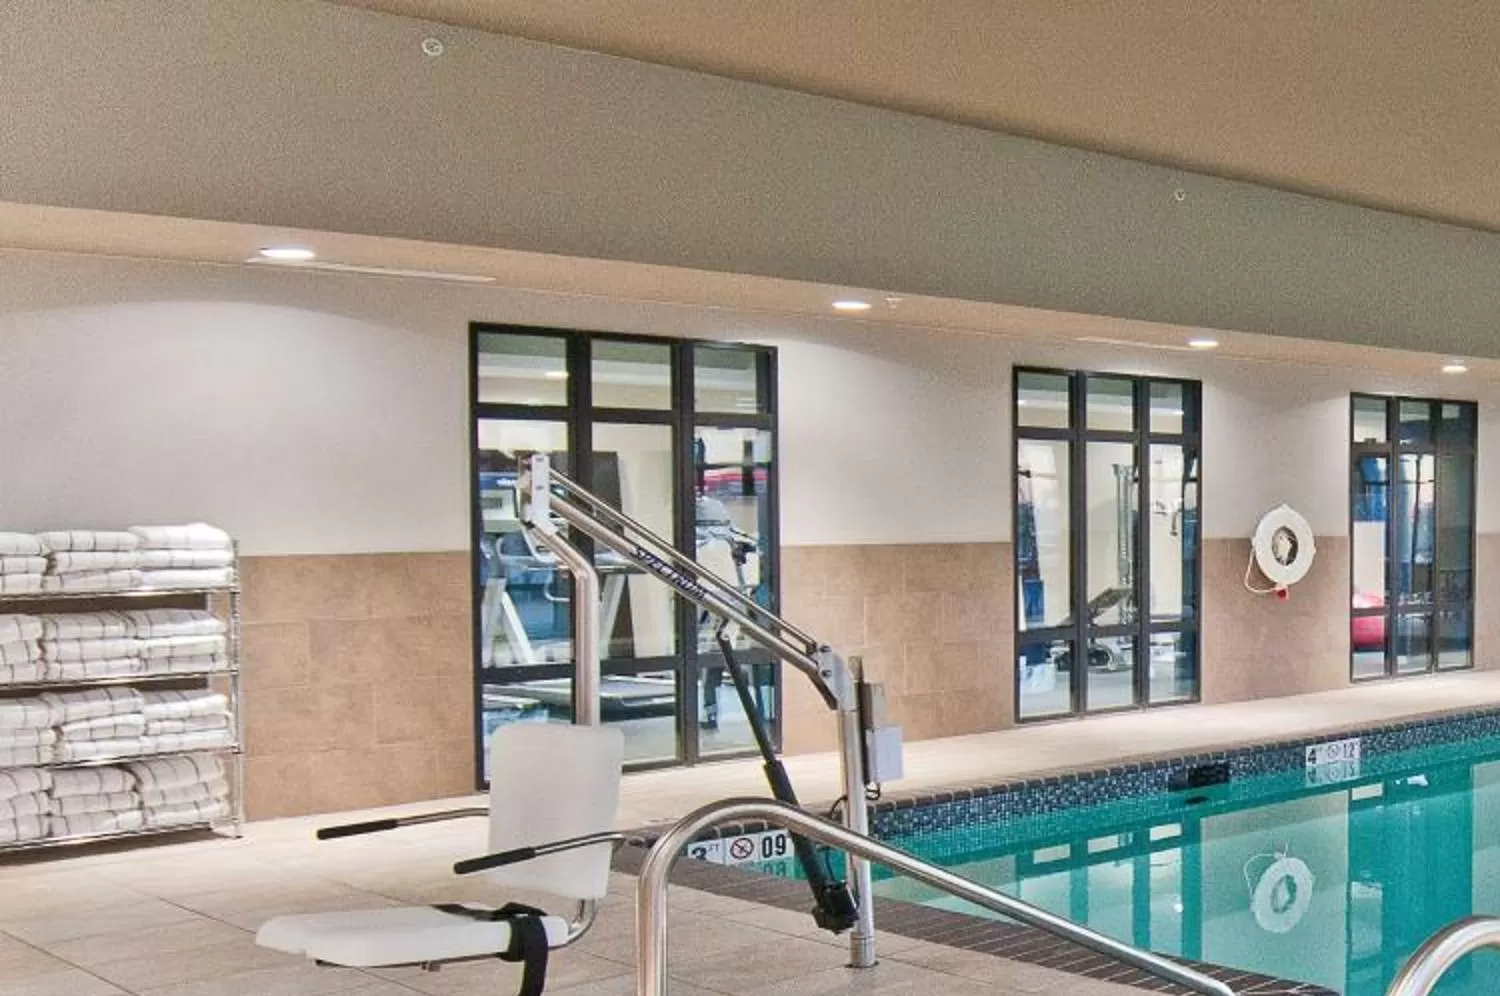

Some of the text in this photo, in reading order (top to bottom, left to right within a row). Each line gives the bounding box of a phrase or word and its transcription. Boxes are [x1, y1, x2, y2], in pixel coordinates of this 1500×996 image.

[631, 546, 706, 601] SPECTRUM
[1307, 748, 1317, 765] 4
[1343, 742, 1356, 759] 12
[762, 834, 787, 859] 09
